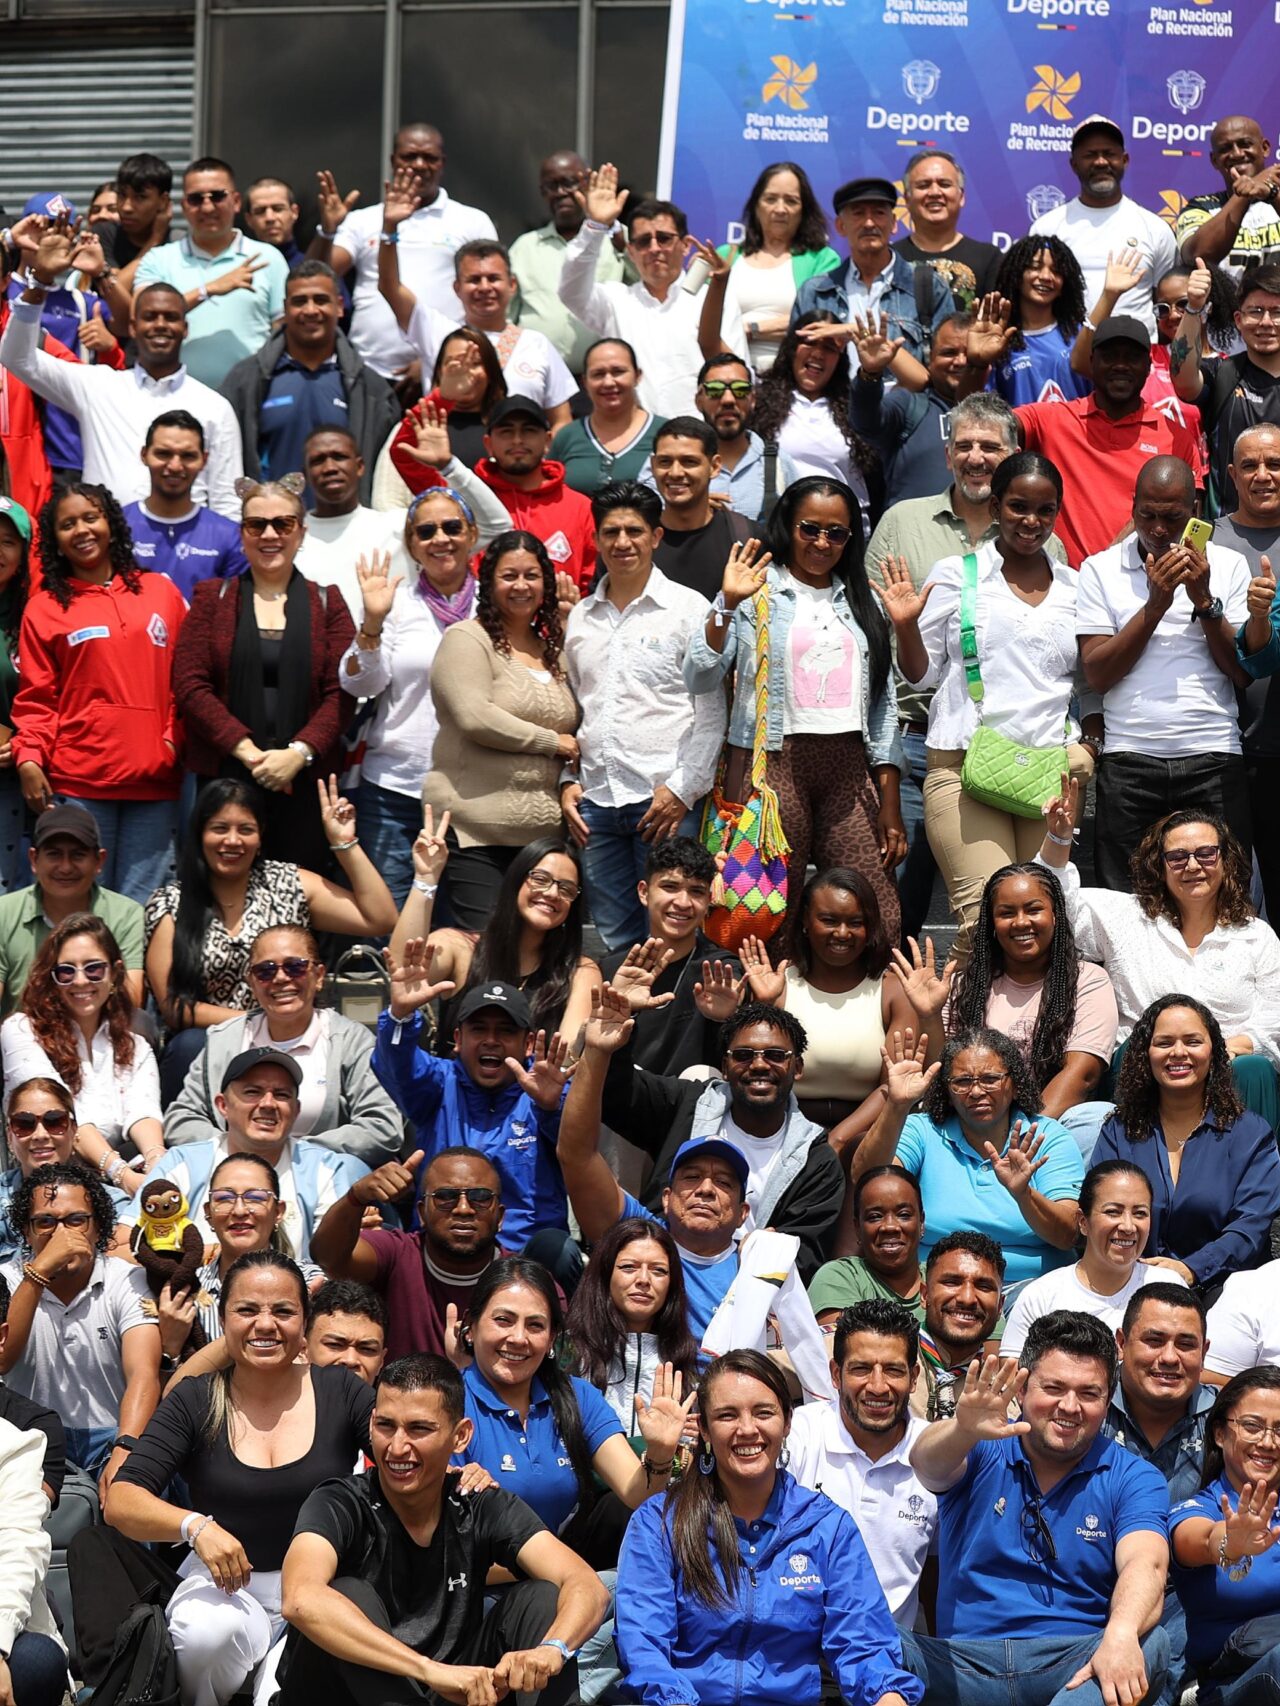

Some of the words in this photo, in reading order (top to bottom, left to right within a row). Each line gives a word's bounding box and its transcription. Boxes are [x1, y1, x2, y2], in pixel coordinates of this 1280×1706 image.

[885, 0, 913, 11] Plan
[915, 0, 968, 13] Nacional
[1007, 0, 1110, 19] Deporte
[882, 10, 900, 24] de
[901, 11, 968, 27] Recreación
[1150, 7, 1176, 20] Plan
[1179, 9, 1232, 24] Nacional
[1147, 19, 1164, 33] de
[1167, 21, 1233, 37] Recreación
[746, 113, 772, 127] Plan
[776, 115, 829, 130] Nacional
[866, 107, 970, 135] Deporte
[743, 125, 760, 139] de
[762, 127, 829, 143] Recreación
[1010, 122, 1037, 136] Plan
[1039, 124, 1075, 139] Nacio
[1132, 116, 1217, 145] Depor
[1007, 137, 1024, 150] de
[1076, 1527, 1107, 1538] Deporte
